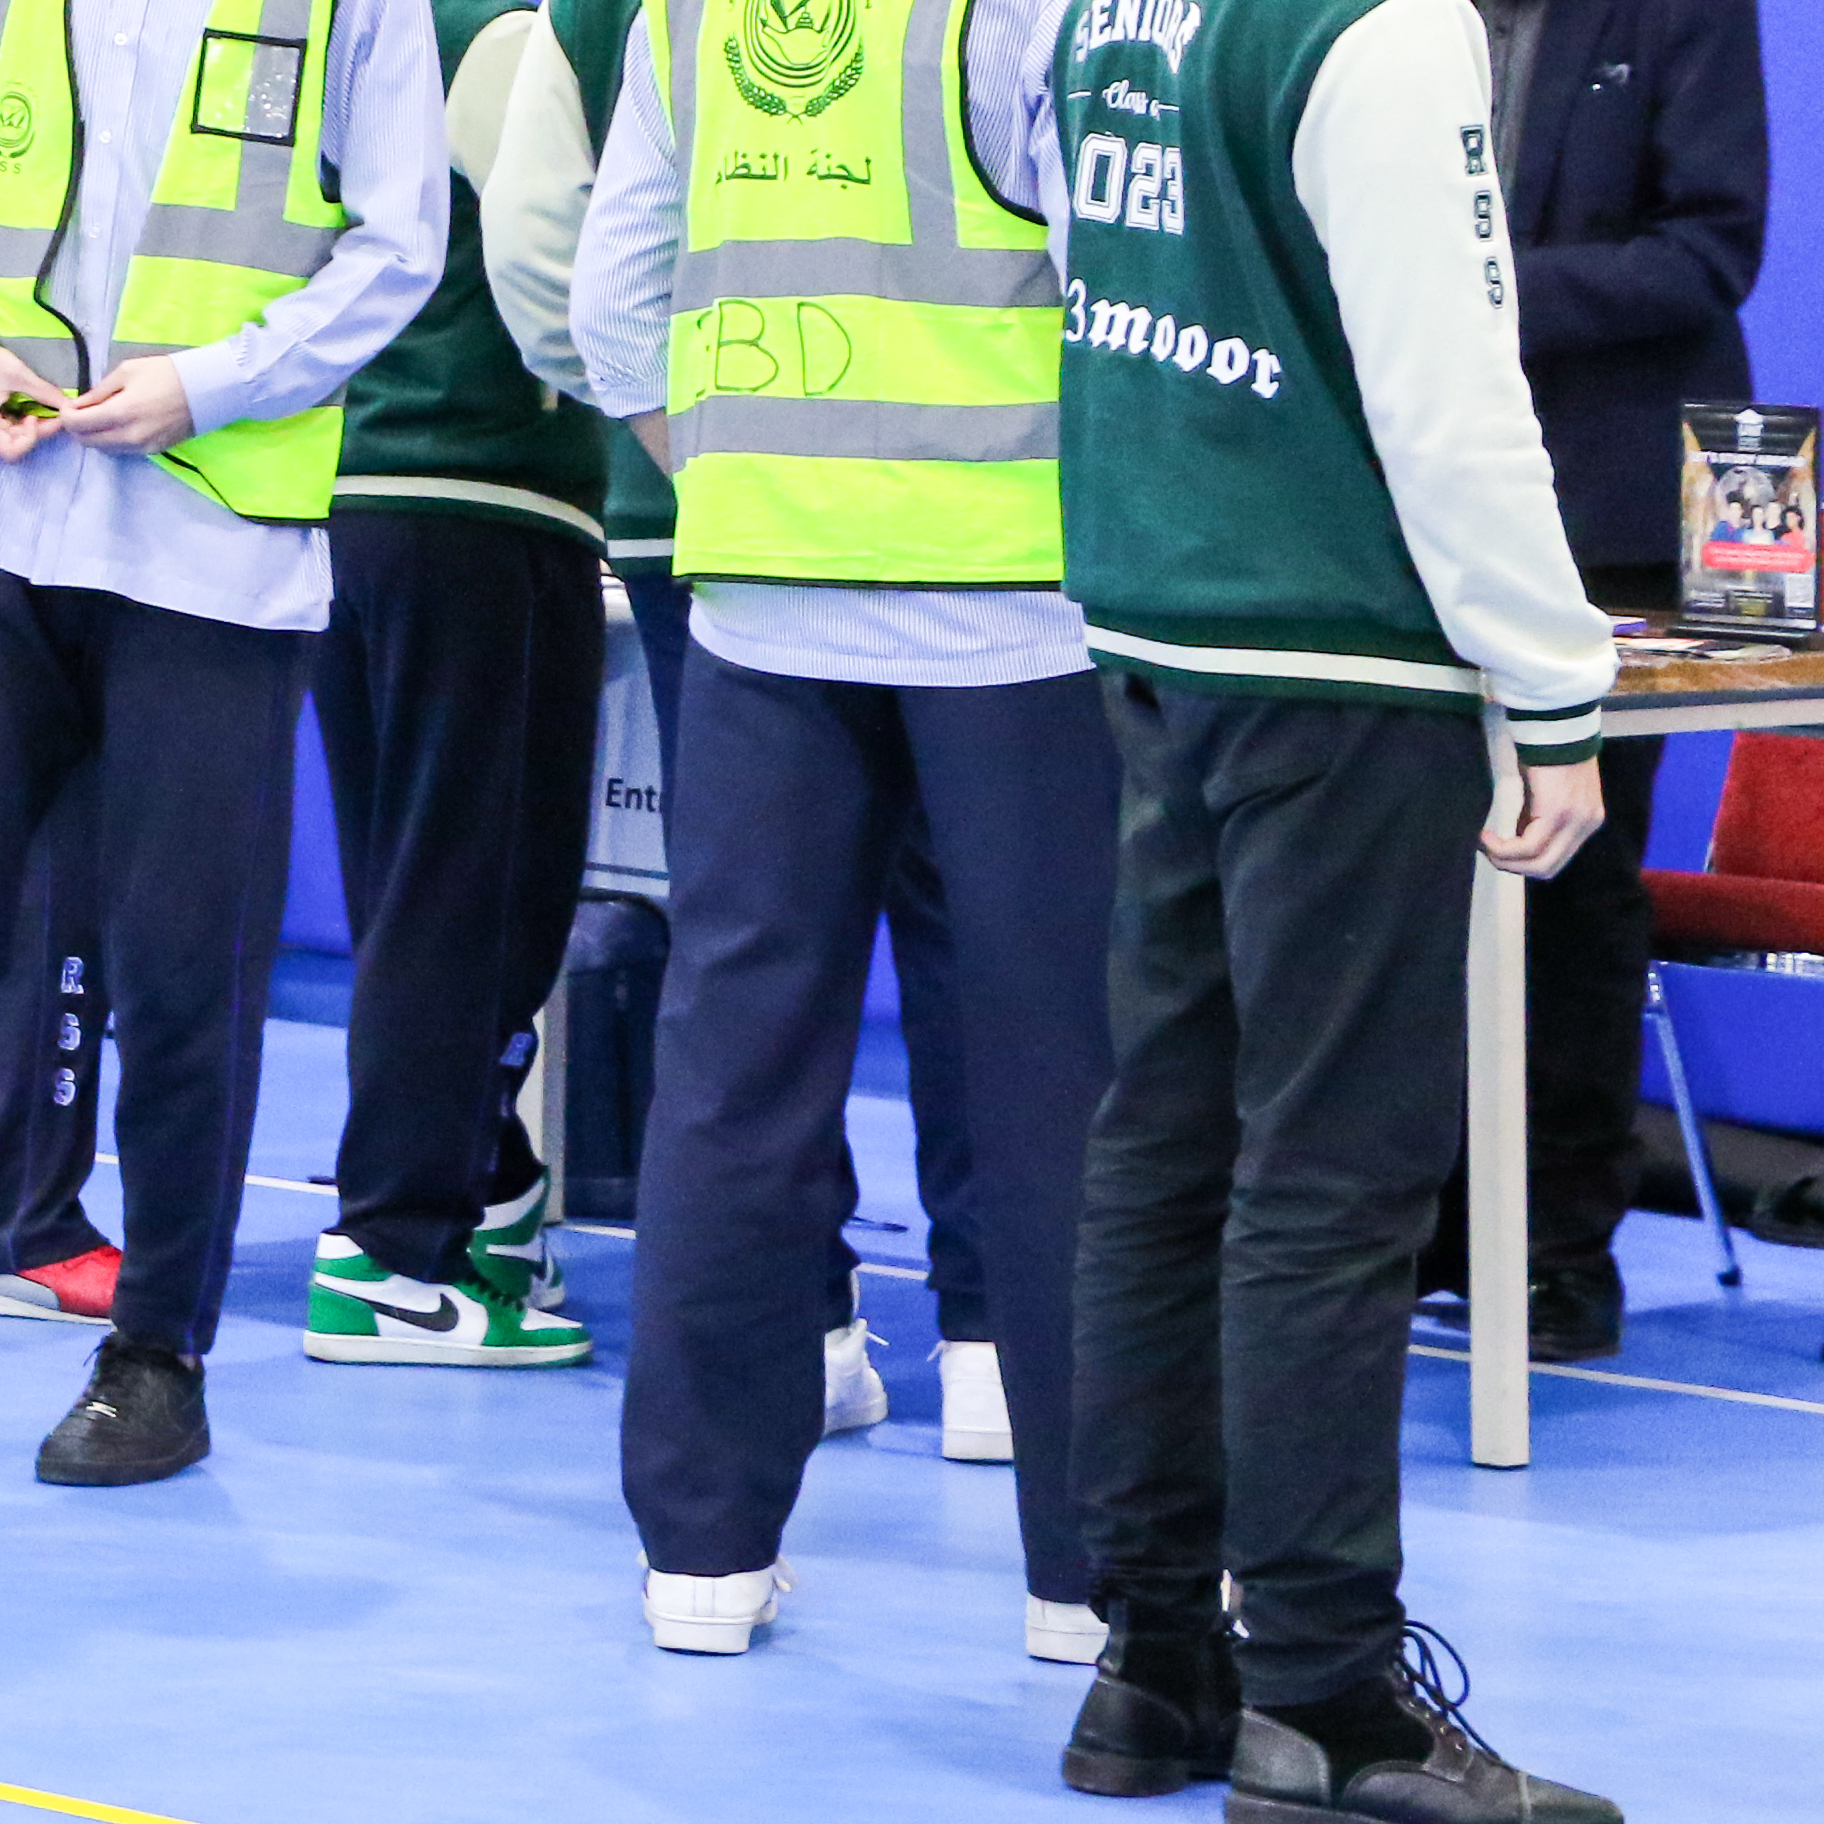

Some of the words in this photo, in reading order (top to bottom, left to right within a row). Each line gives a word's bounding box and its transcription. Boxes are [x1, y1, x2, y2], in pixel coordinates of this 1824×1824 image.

[805, 147, 872, 190] لجنة
[1072, 129, 1185, 236] 023
[605, 777, 658, 813] Ent
[52, 956, 85, 1107] RSS
